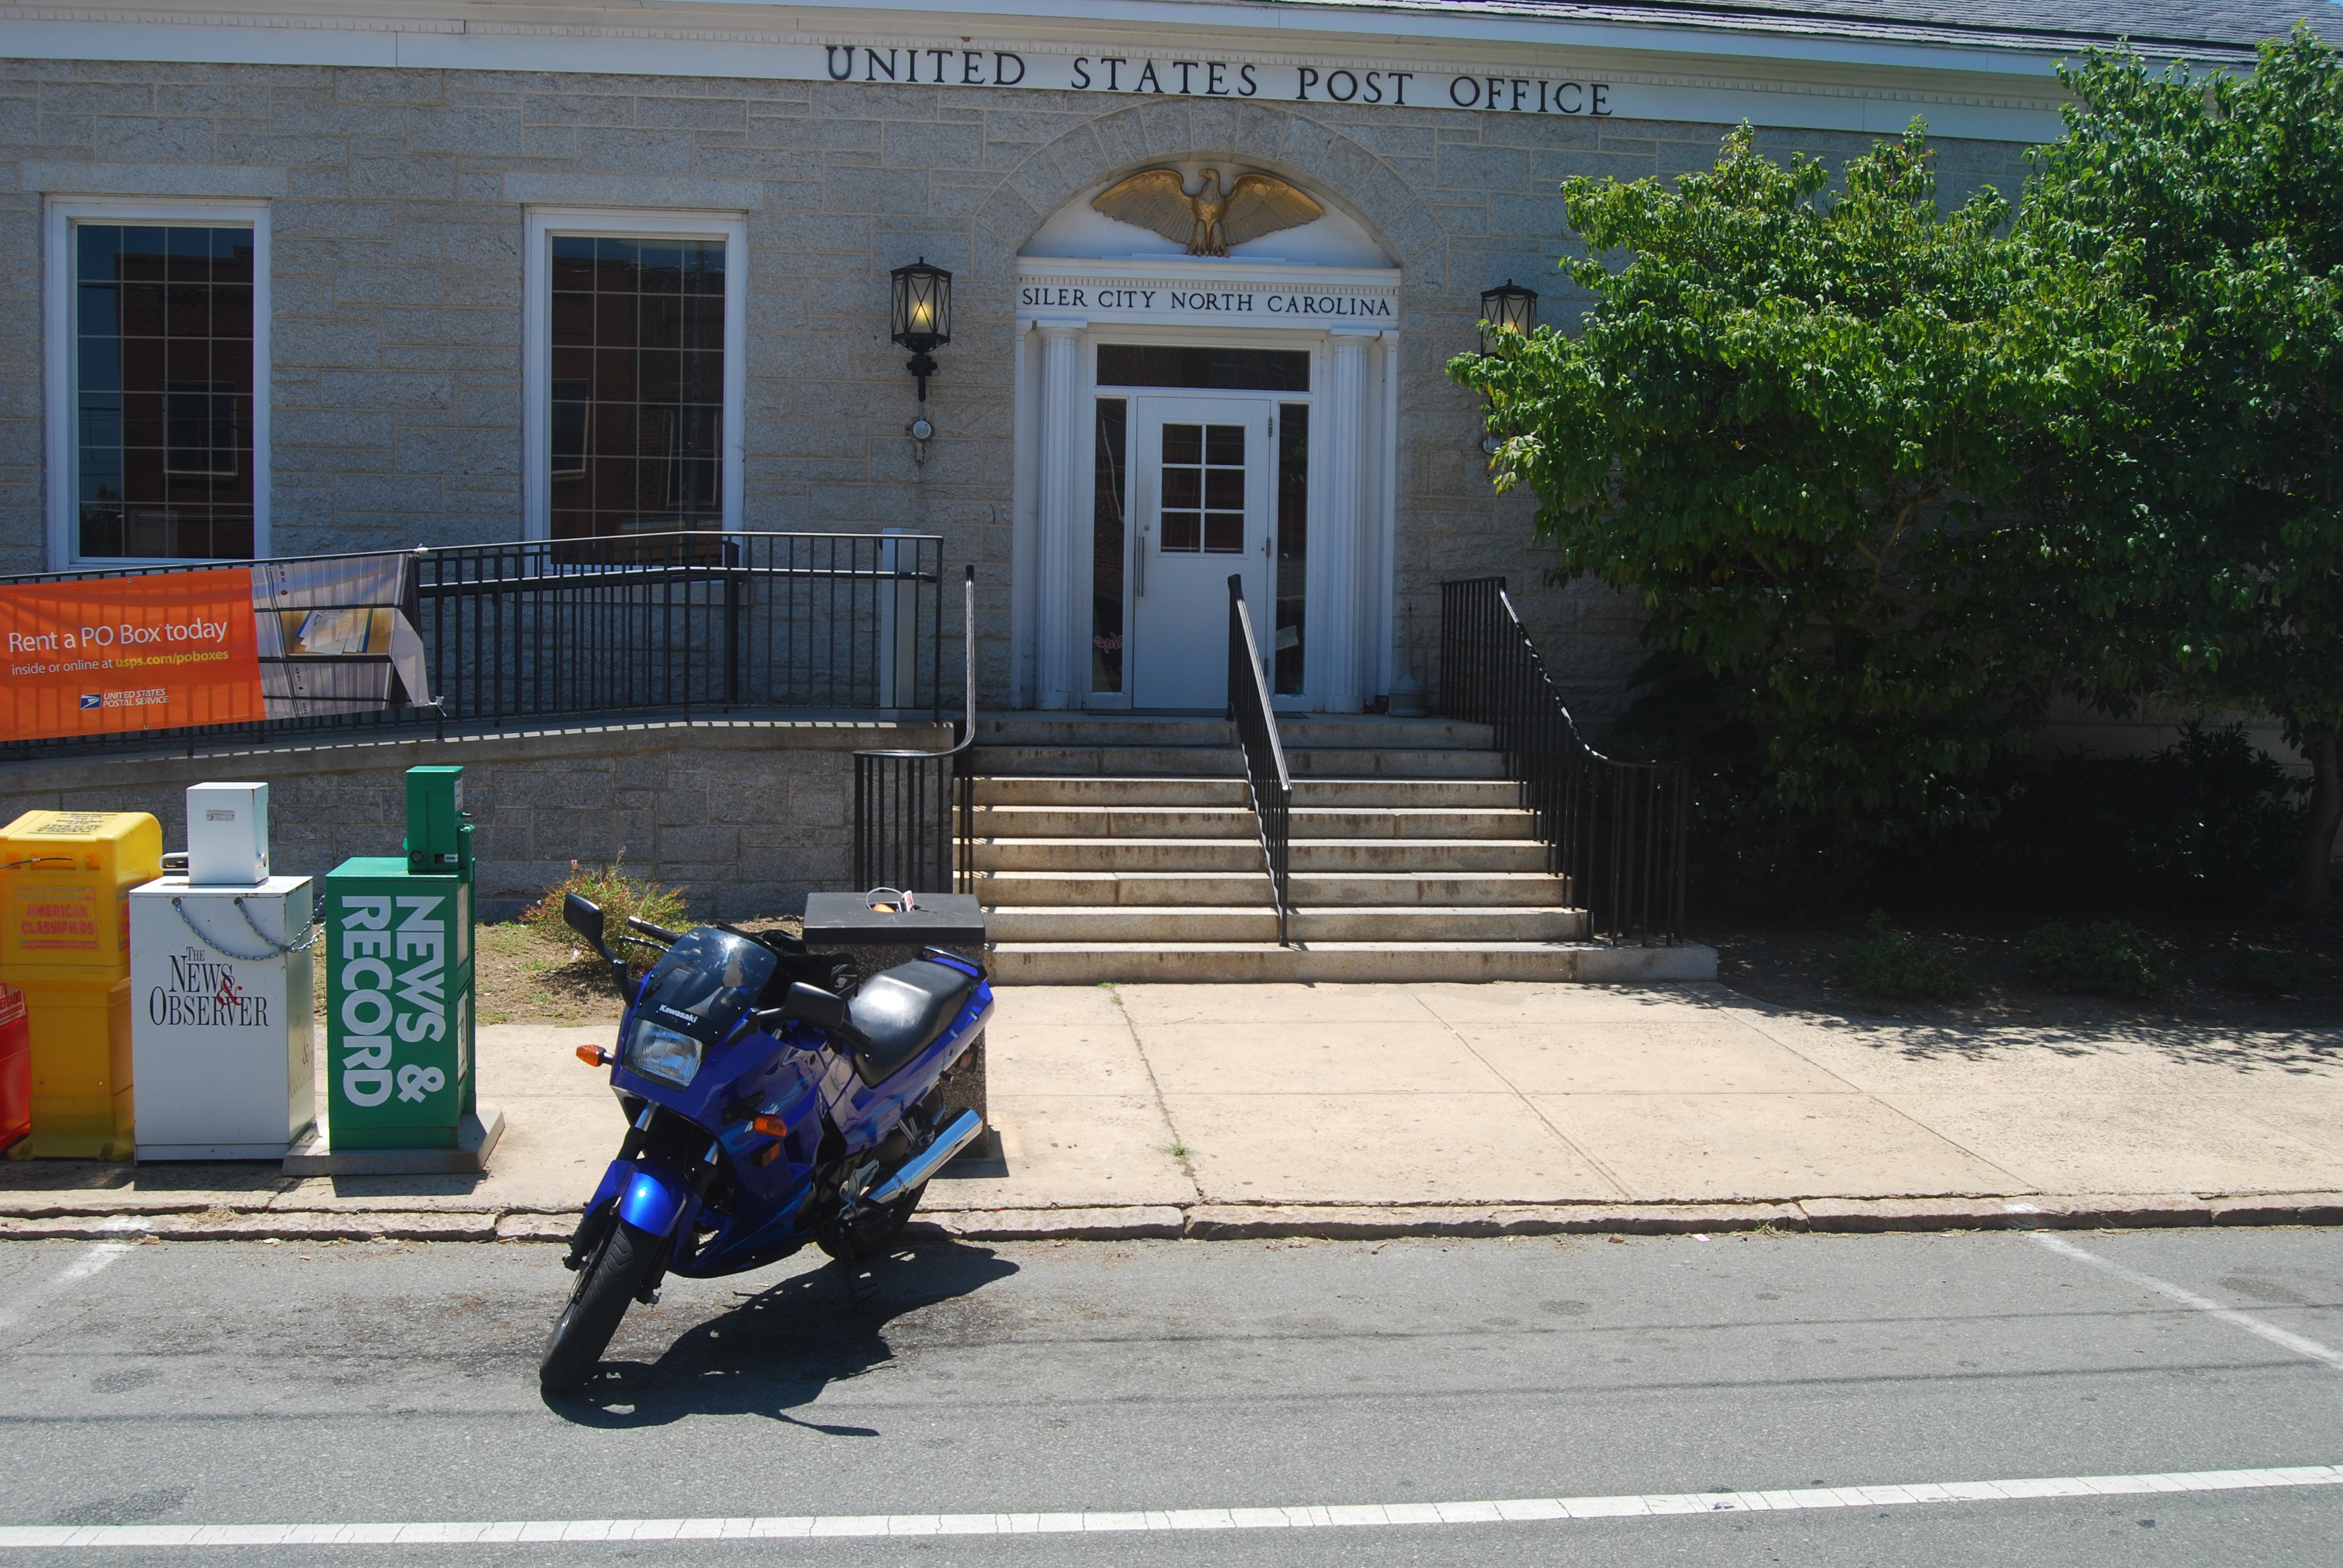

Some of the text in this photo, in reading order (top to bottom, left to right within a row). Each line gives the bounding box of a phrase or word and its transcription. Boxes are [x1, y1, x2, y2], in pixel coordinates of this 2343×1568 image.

[826, 46, 1613, 116] UNITED STATES POST OFFICE
[1022, 288, 1391, 316] SILER CITY NORTH CAROLINA
[8, 618, 228, 653] Rent a PO Box today
[11, 650, 229, 676] inside or online at usps.com/poboxes
[103, 688, 166, 701] UNITED STATES
[103, 696, 169, 708] POSTAL SERVICE
[26, 904, 88, 918] AMERICAN
[21, 920, 95, 935] CLASSIFIEDS
[341, 895, 393, 1108] RECORD
[395, 895, 447, 1103] NEWS &
[658, 1004, 698, 1024] Kawasaki
